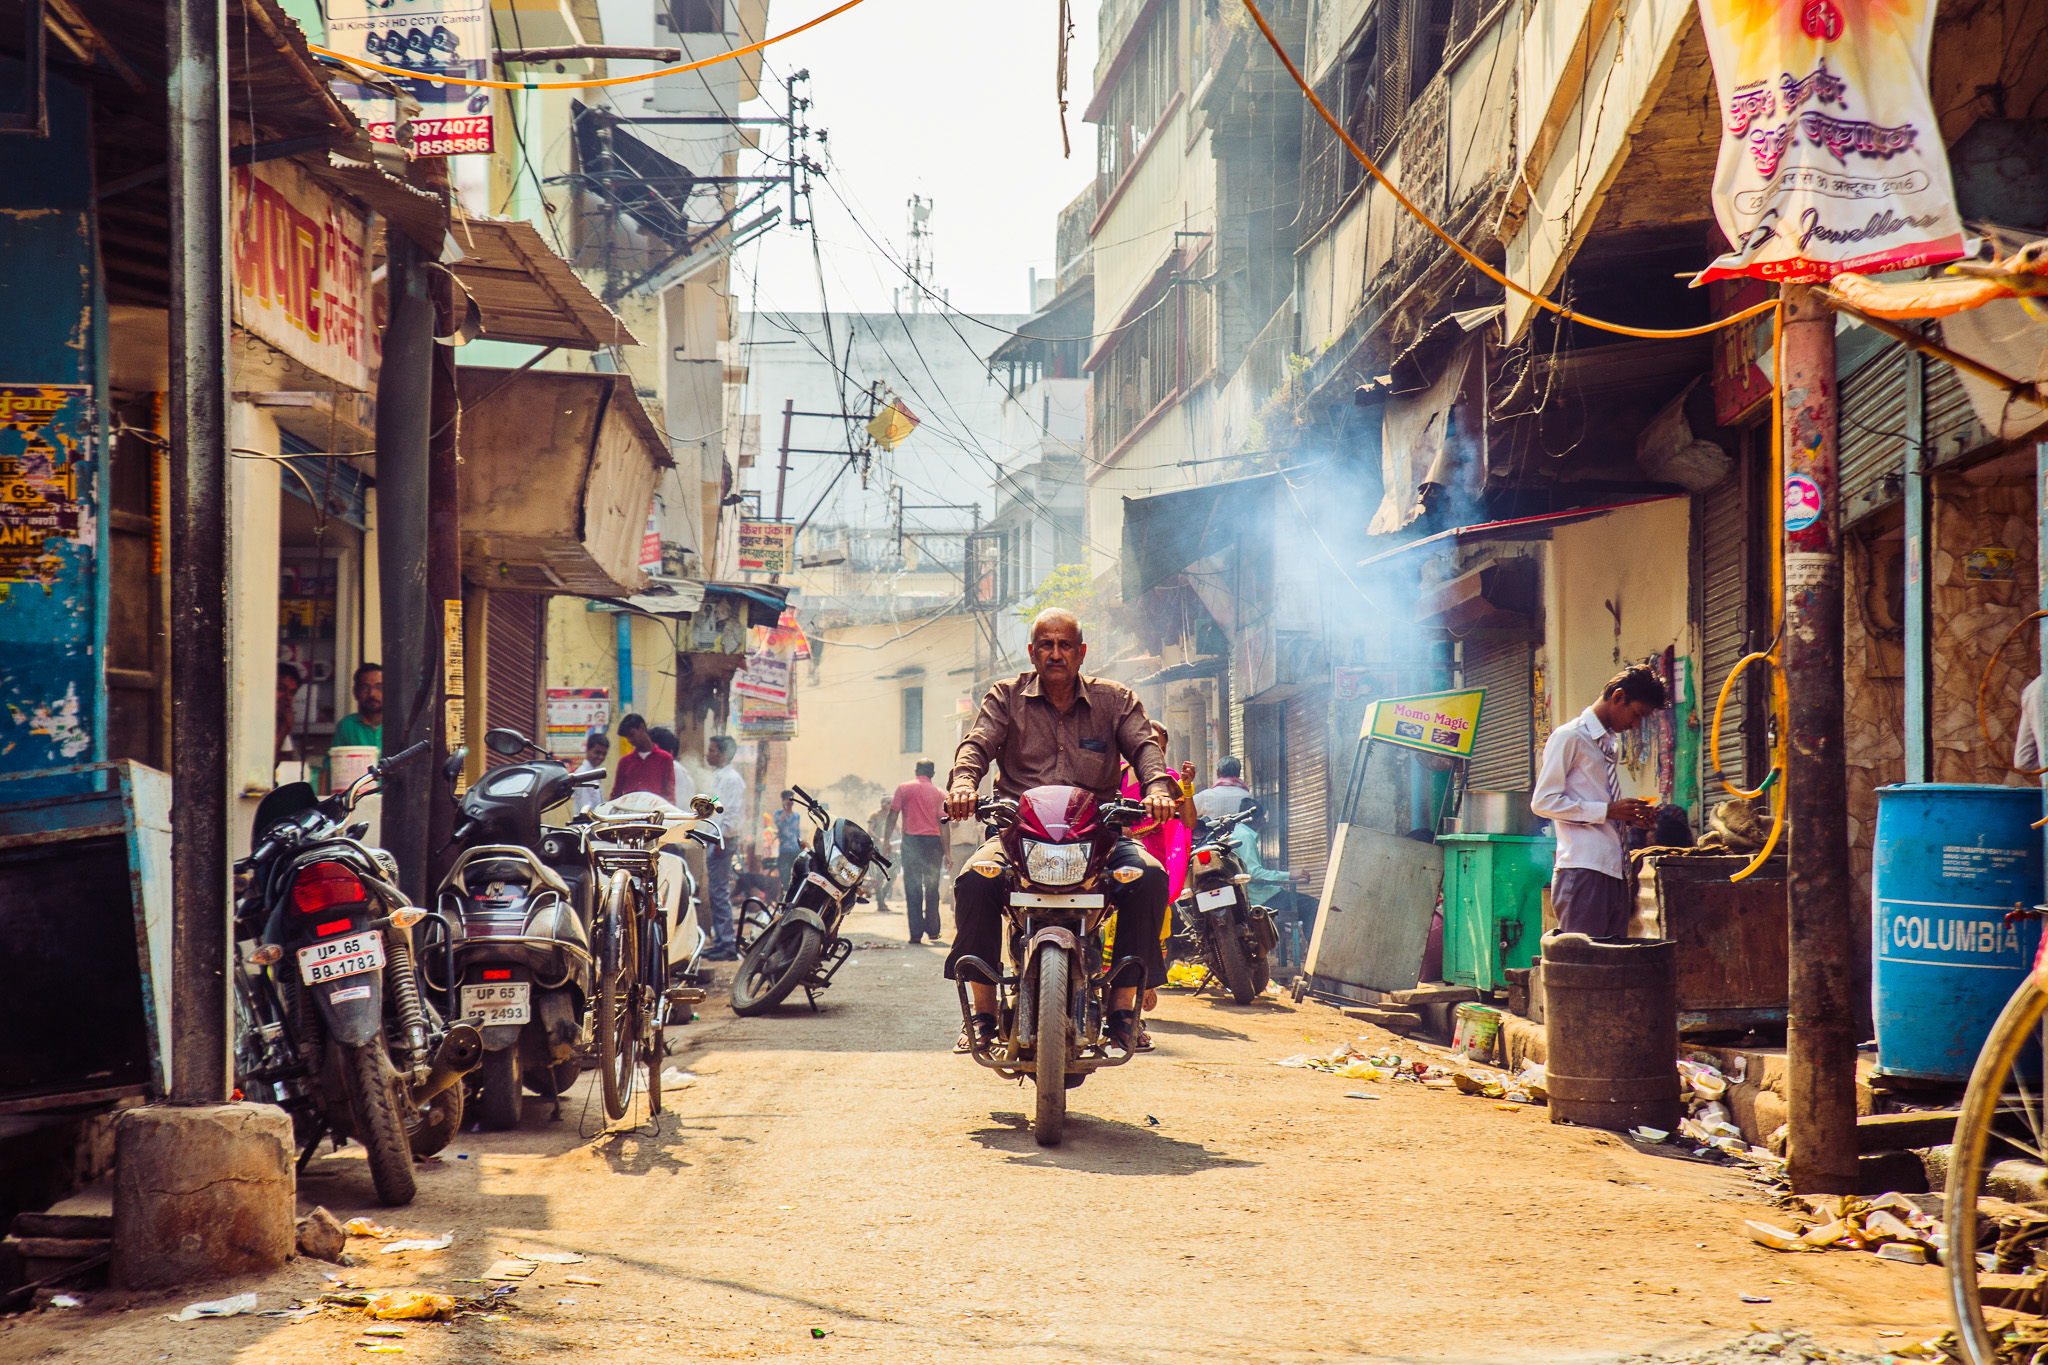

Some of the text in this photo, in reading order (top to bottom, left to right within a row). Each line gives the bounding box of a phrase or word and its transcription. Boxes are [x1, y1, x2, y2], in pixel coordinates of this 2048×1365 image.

[330, 14, 481, 31] All Kinds of HD CCTV Camera
[1882, 179, 1914, 193] 2016
[1798, 207, 1941, 252] Jewellers
[1393, 704, 1470, 730] Momo Magic
[1893, 915, 2020, 953] COLUMBIA
[477, 987, 515, 1000] UP 65
[490, 1007, 523, 1020] 2493
